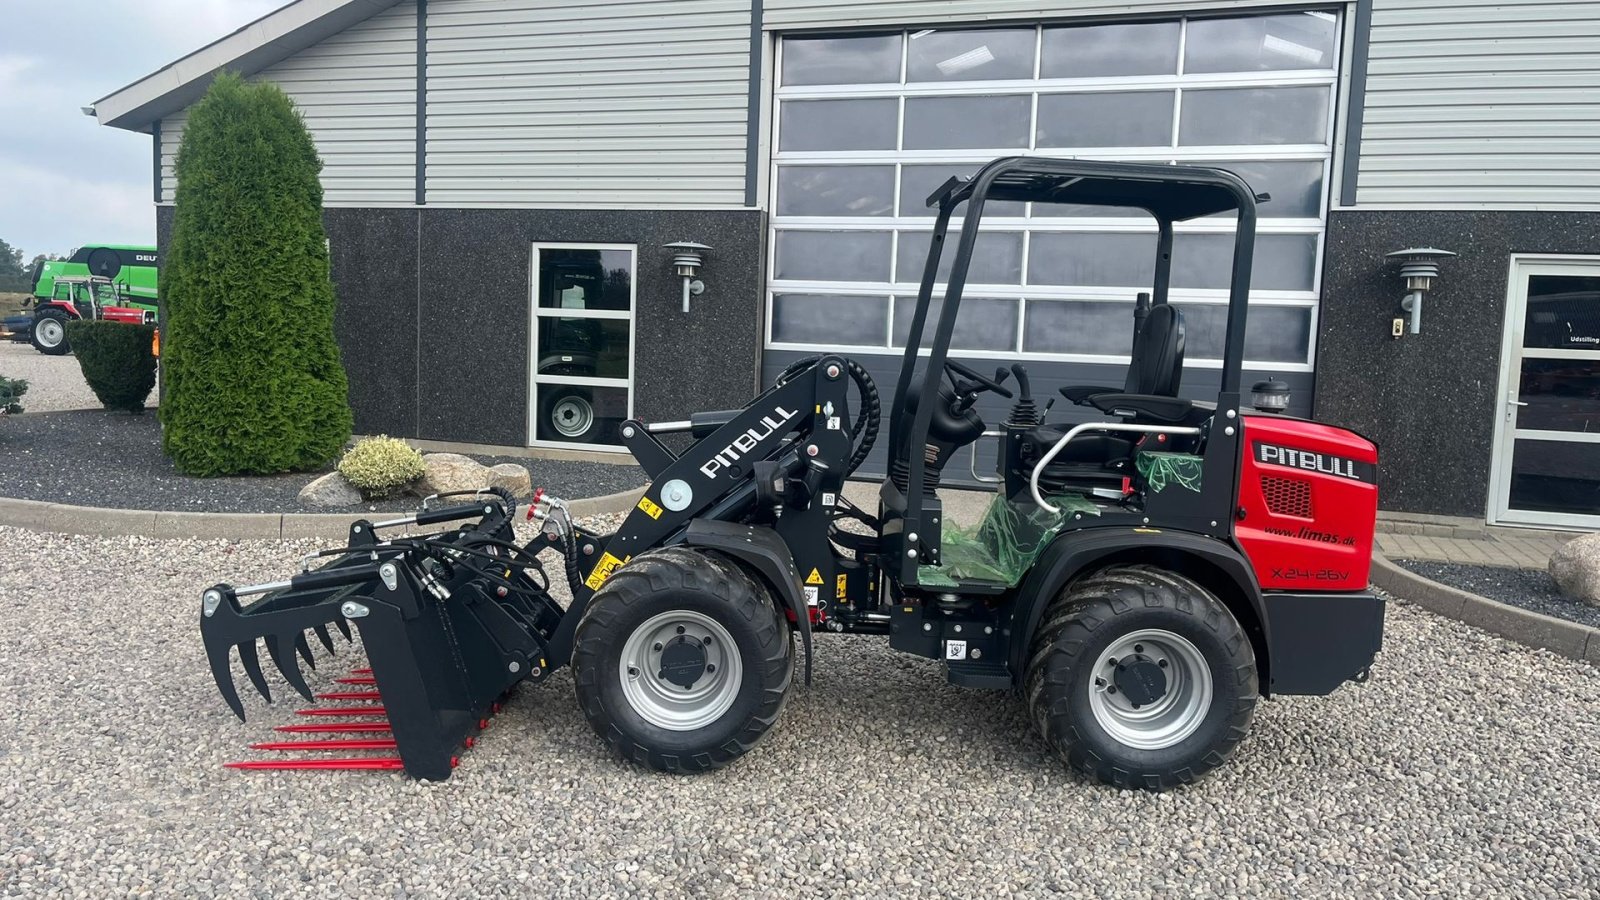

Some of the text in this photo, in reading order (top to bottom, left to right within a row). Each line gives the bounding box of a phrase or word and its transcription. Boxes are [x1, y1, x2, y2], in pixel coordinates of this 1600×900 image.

[136, 254, 157, 262] DEU
[1570, 336, 1600, 344] Udstilling
[700, 406, 799, 479] PITBULL
[1261, 444, 1360, 479] PITBULL
[1264, 526, 1356, 546] www.limas.dk
